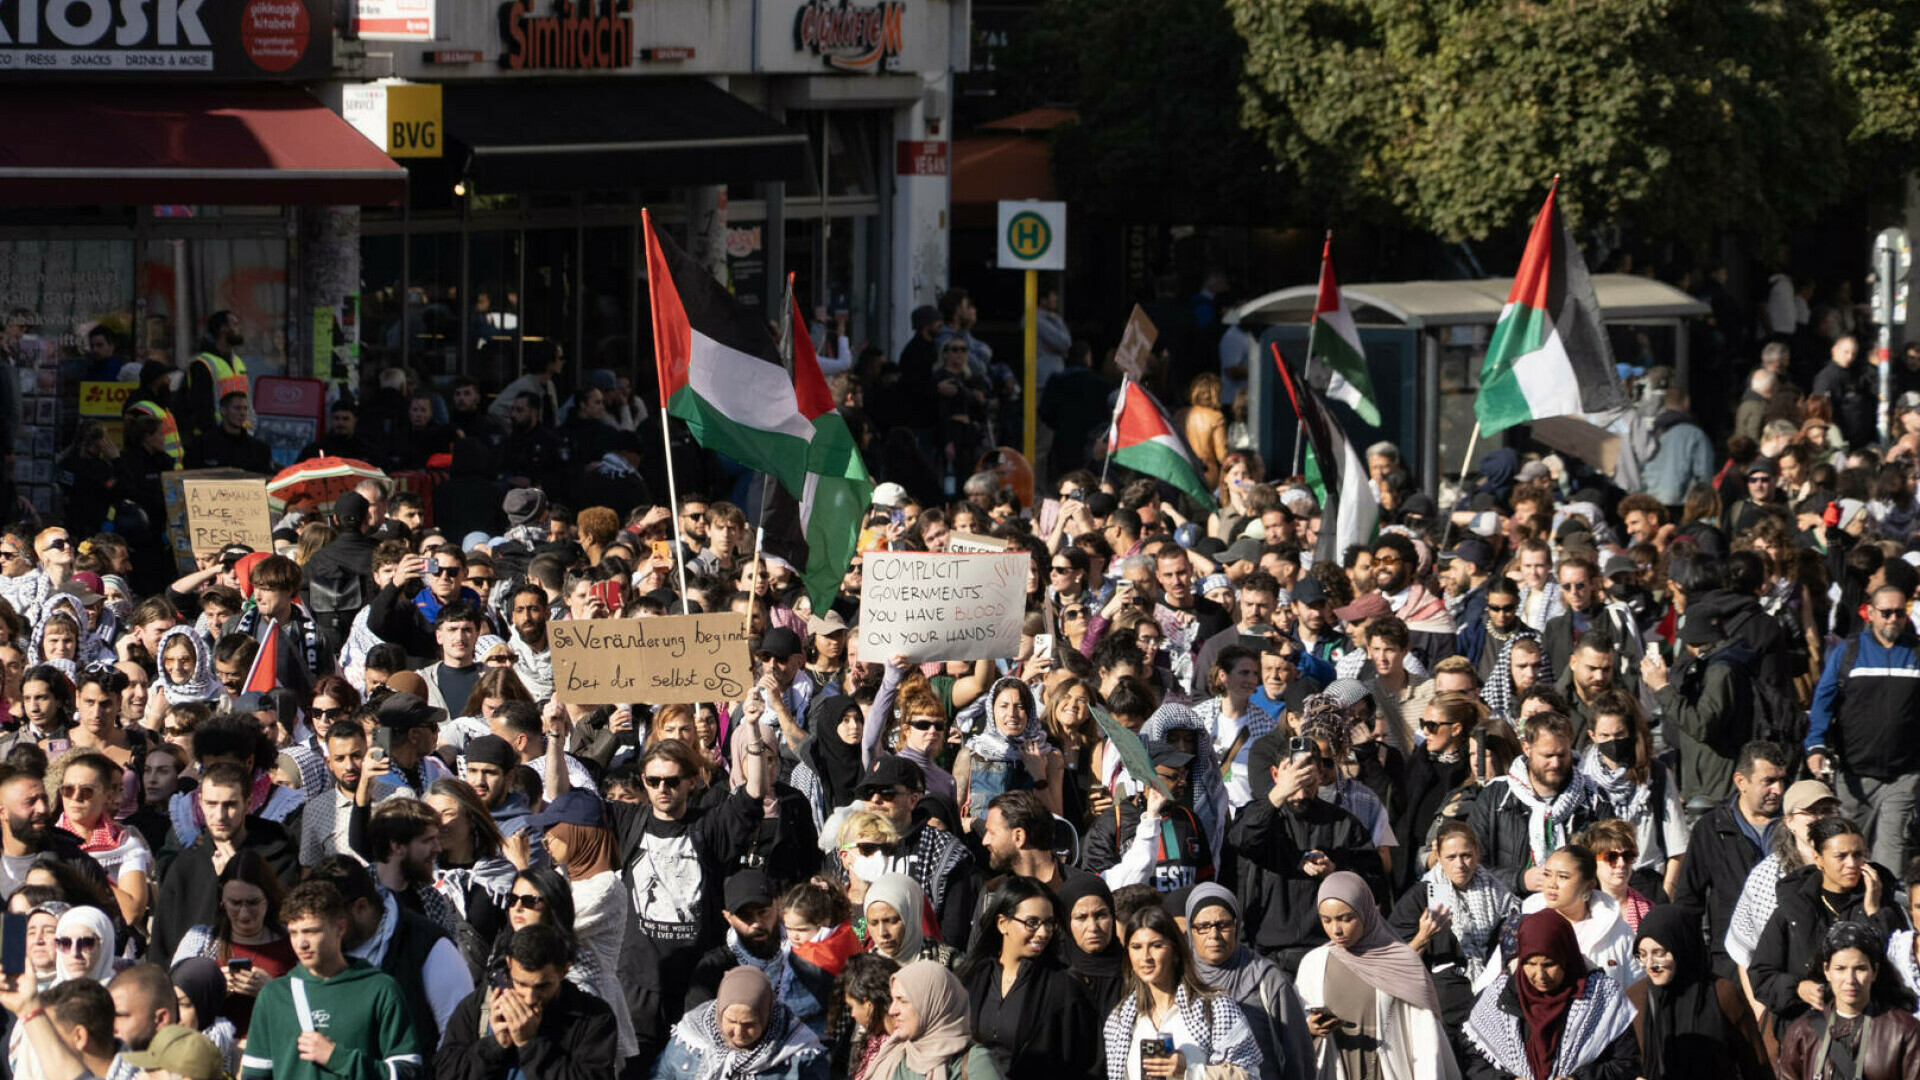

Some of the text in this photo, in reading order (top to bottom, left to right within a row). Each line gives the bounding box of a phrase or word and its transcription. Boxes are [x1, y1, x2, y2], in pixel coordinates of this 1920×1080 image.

[0, 0, 212, 46] IOSK
[25, 53, 57, 65] PRESS
[70, 54, 112, 66] SNACKS
[126, 54, 165, 66] DRINKS
[179, 55, 209, 66] MORE
[345, 99, 375, 111] SERVICE
[392, 121, 436, 149] BVG
[191, 488, 201, 502] A
[191, 505, 232, 518] PLACE
[222, 518, 246, 527] THE
[872, 559, 970, 581] COMPLICIT
[868, 603, 1006, 624] YOU HAVE BLOOD
[573, 620, 749, 658] Veränderung beginnt
[868, 624, 996, 645] ON YOUR HANDS
[567, 661, 699, 691] bei dir selbst
[658, 923, 668, 931] THE
